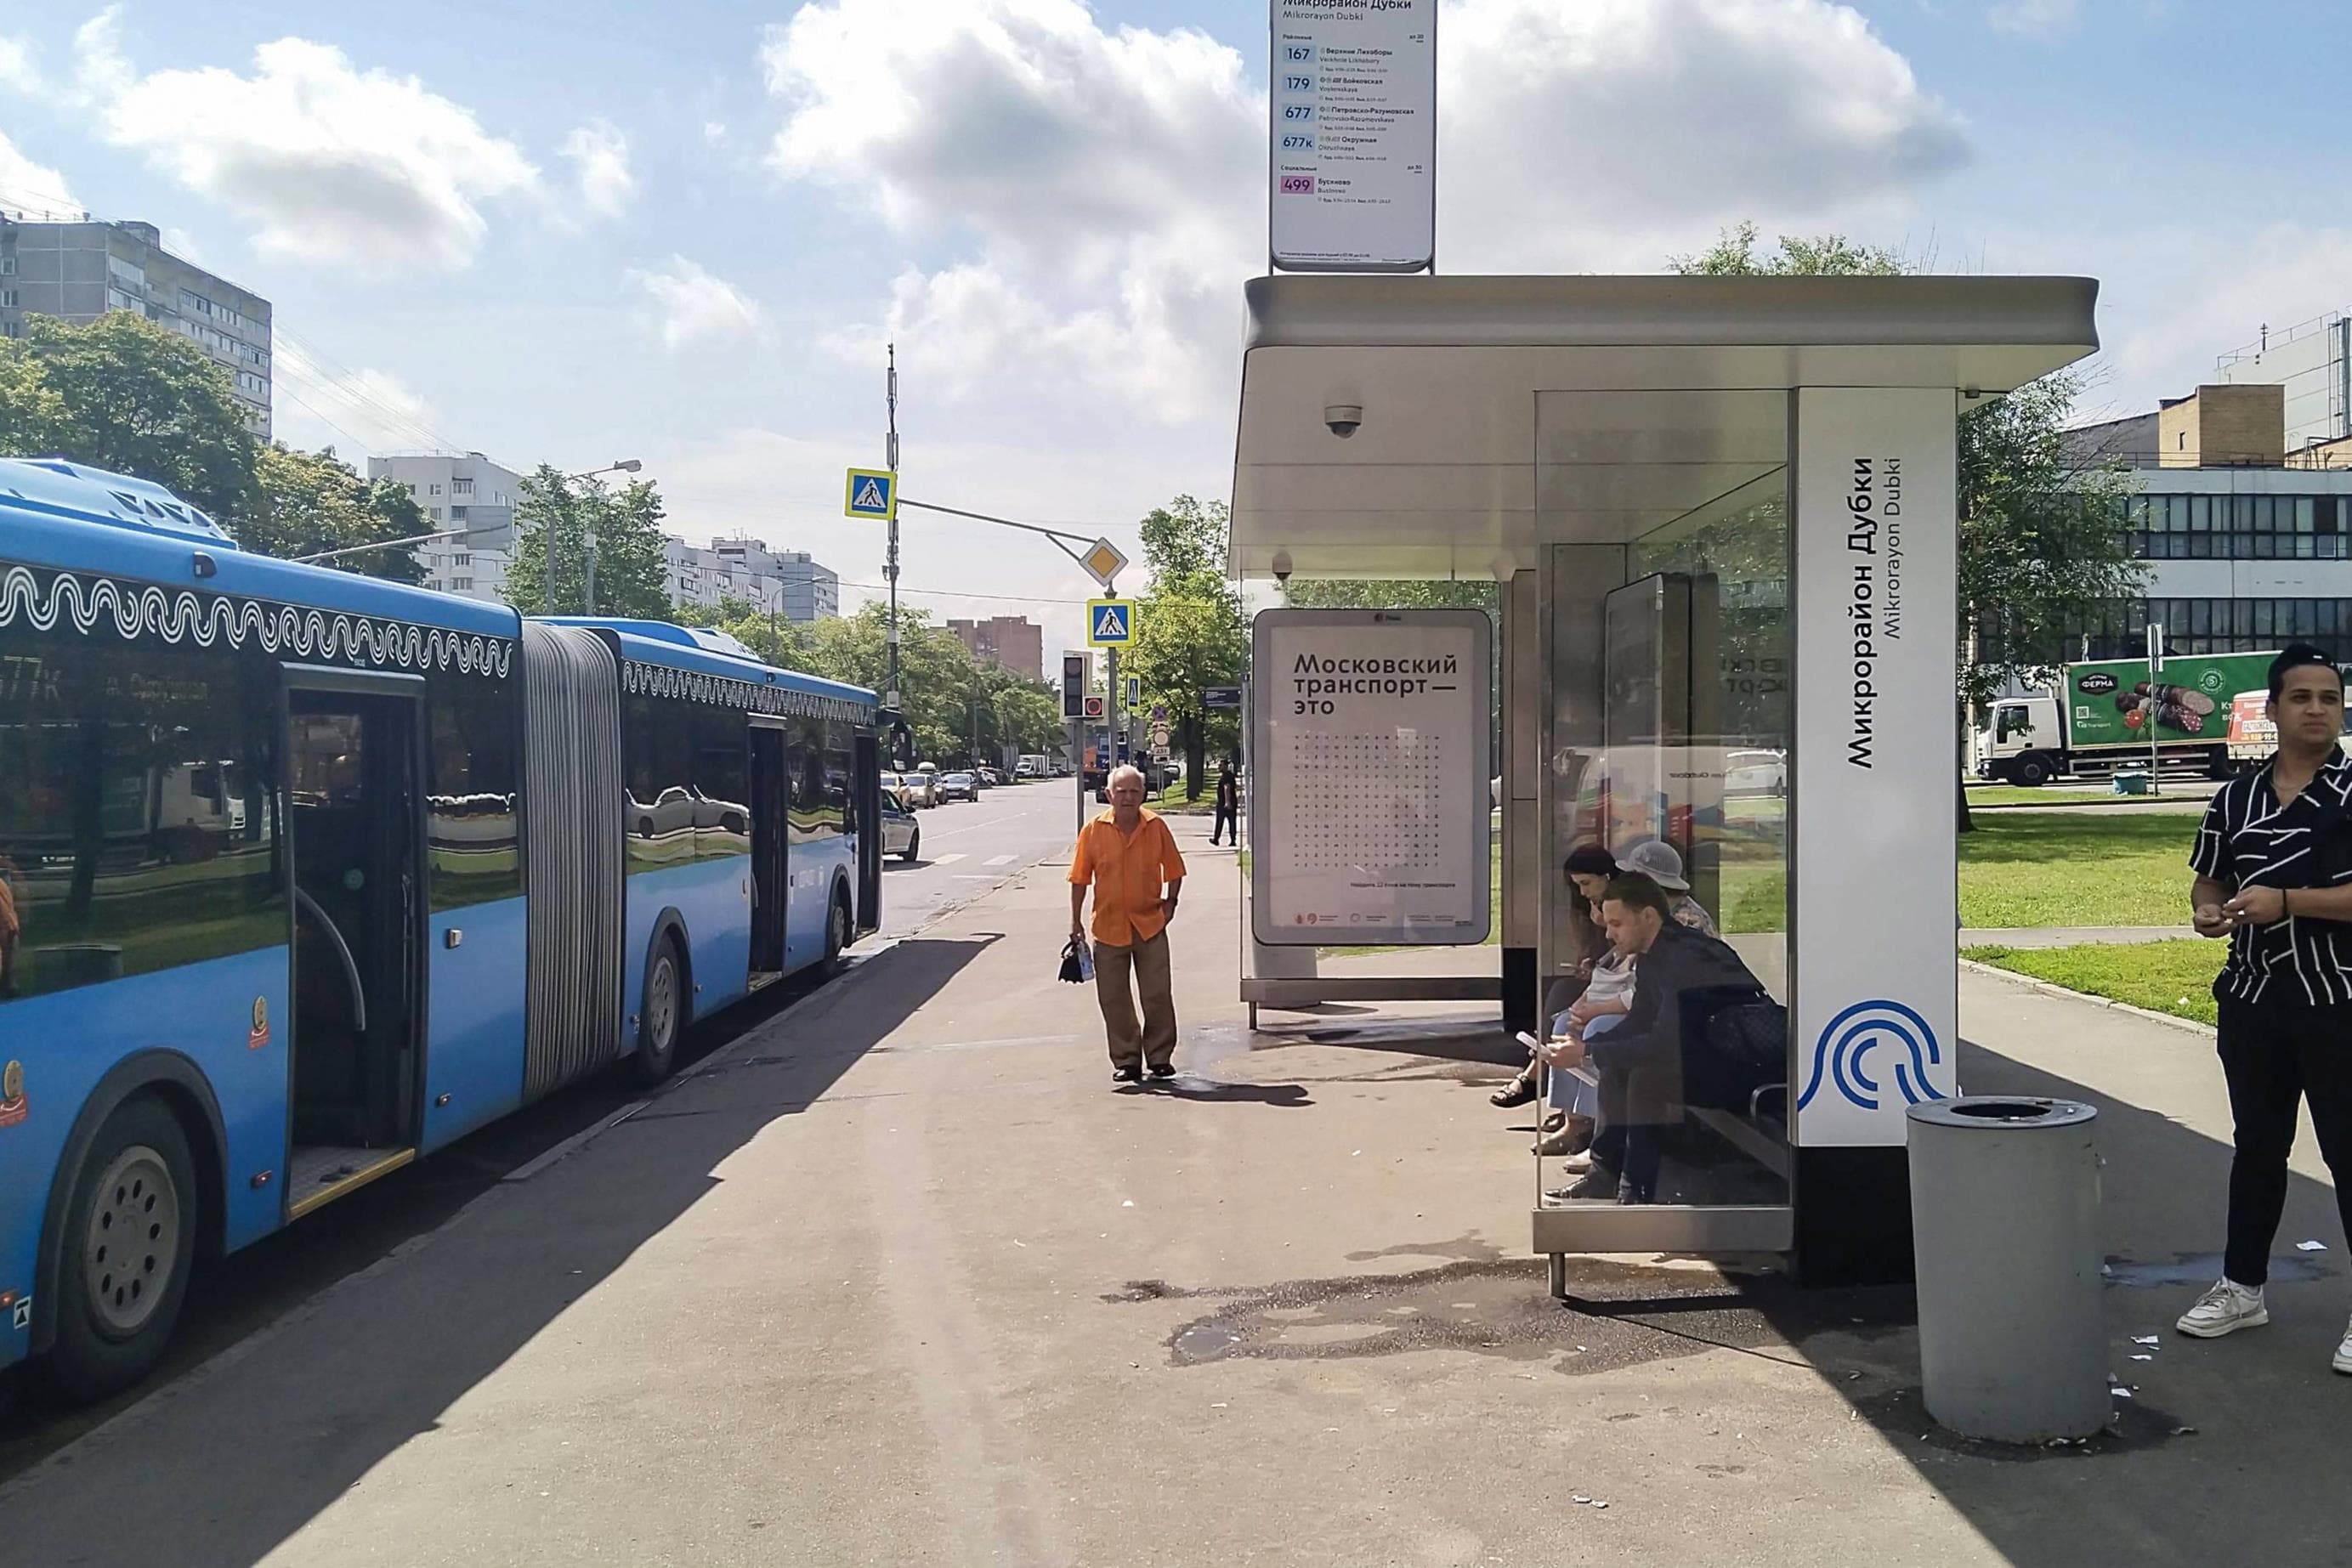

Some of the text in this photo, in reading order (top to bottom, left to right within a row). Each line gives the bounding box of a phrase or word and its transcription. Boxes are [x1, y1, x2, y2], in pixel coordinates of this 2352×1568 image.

[1282, 10, 1363, 21] Mikrorayon Dubki
[1288, 48, 1310, 60] 167
[1288, 77, 1310, 90] 179
[1285, 106, 1311, 119] 677
[1284, 178, 1310, 190] 499
[1883, 457, 1904, 640] Mikrorayon Dubki
[1848, 457, 1878, 769] Микрорайон Дубки
[1293, 654, 1458, 675] Московский
[1293, 699, 1335, 716] это
